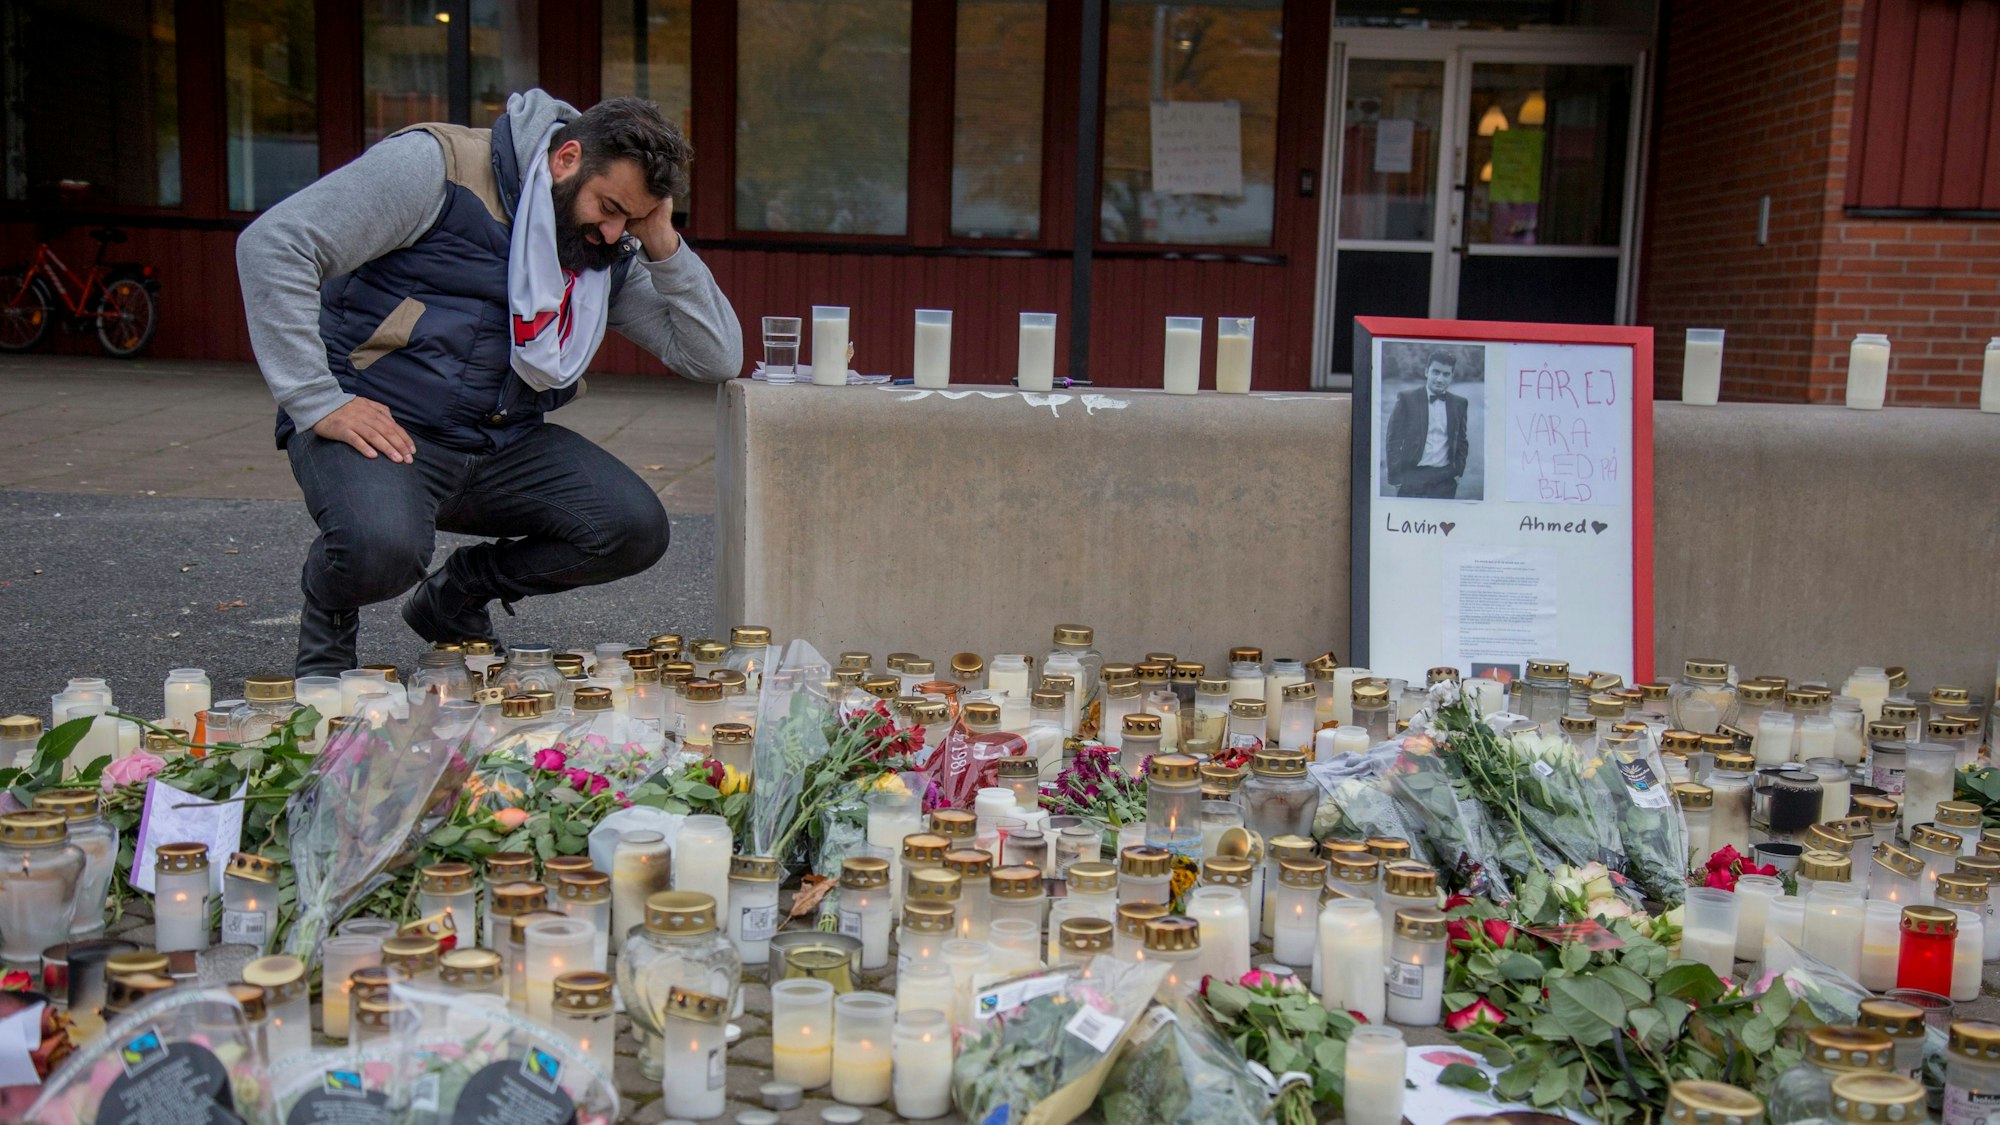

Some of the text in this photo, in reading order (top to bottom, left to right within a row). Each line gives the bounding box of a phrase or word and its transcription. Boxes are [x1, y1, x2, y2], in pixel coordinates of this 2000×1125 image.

[1518, 361, 1616, 408] FÅR EJ
[1516, 412, 1592, 453] VARA
[1521, 446, 1619, 481] MED PÅ
[1538, 478, 1592, 501] BILD
[1386, 512, 1437, 535] Lavin
[1519, 515, 1587, 534] Ahmed
[950, 744, 969, 777] 1981
